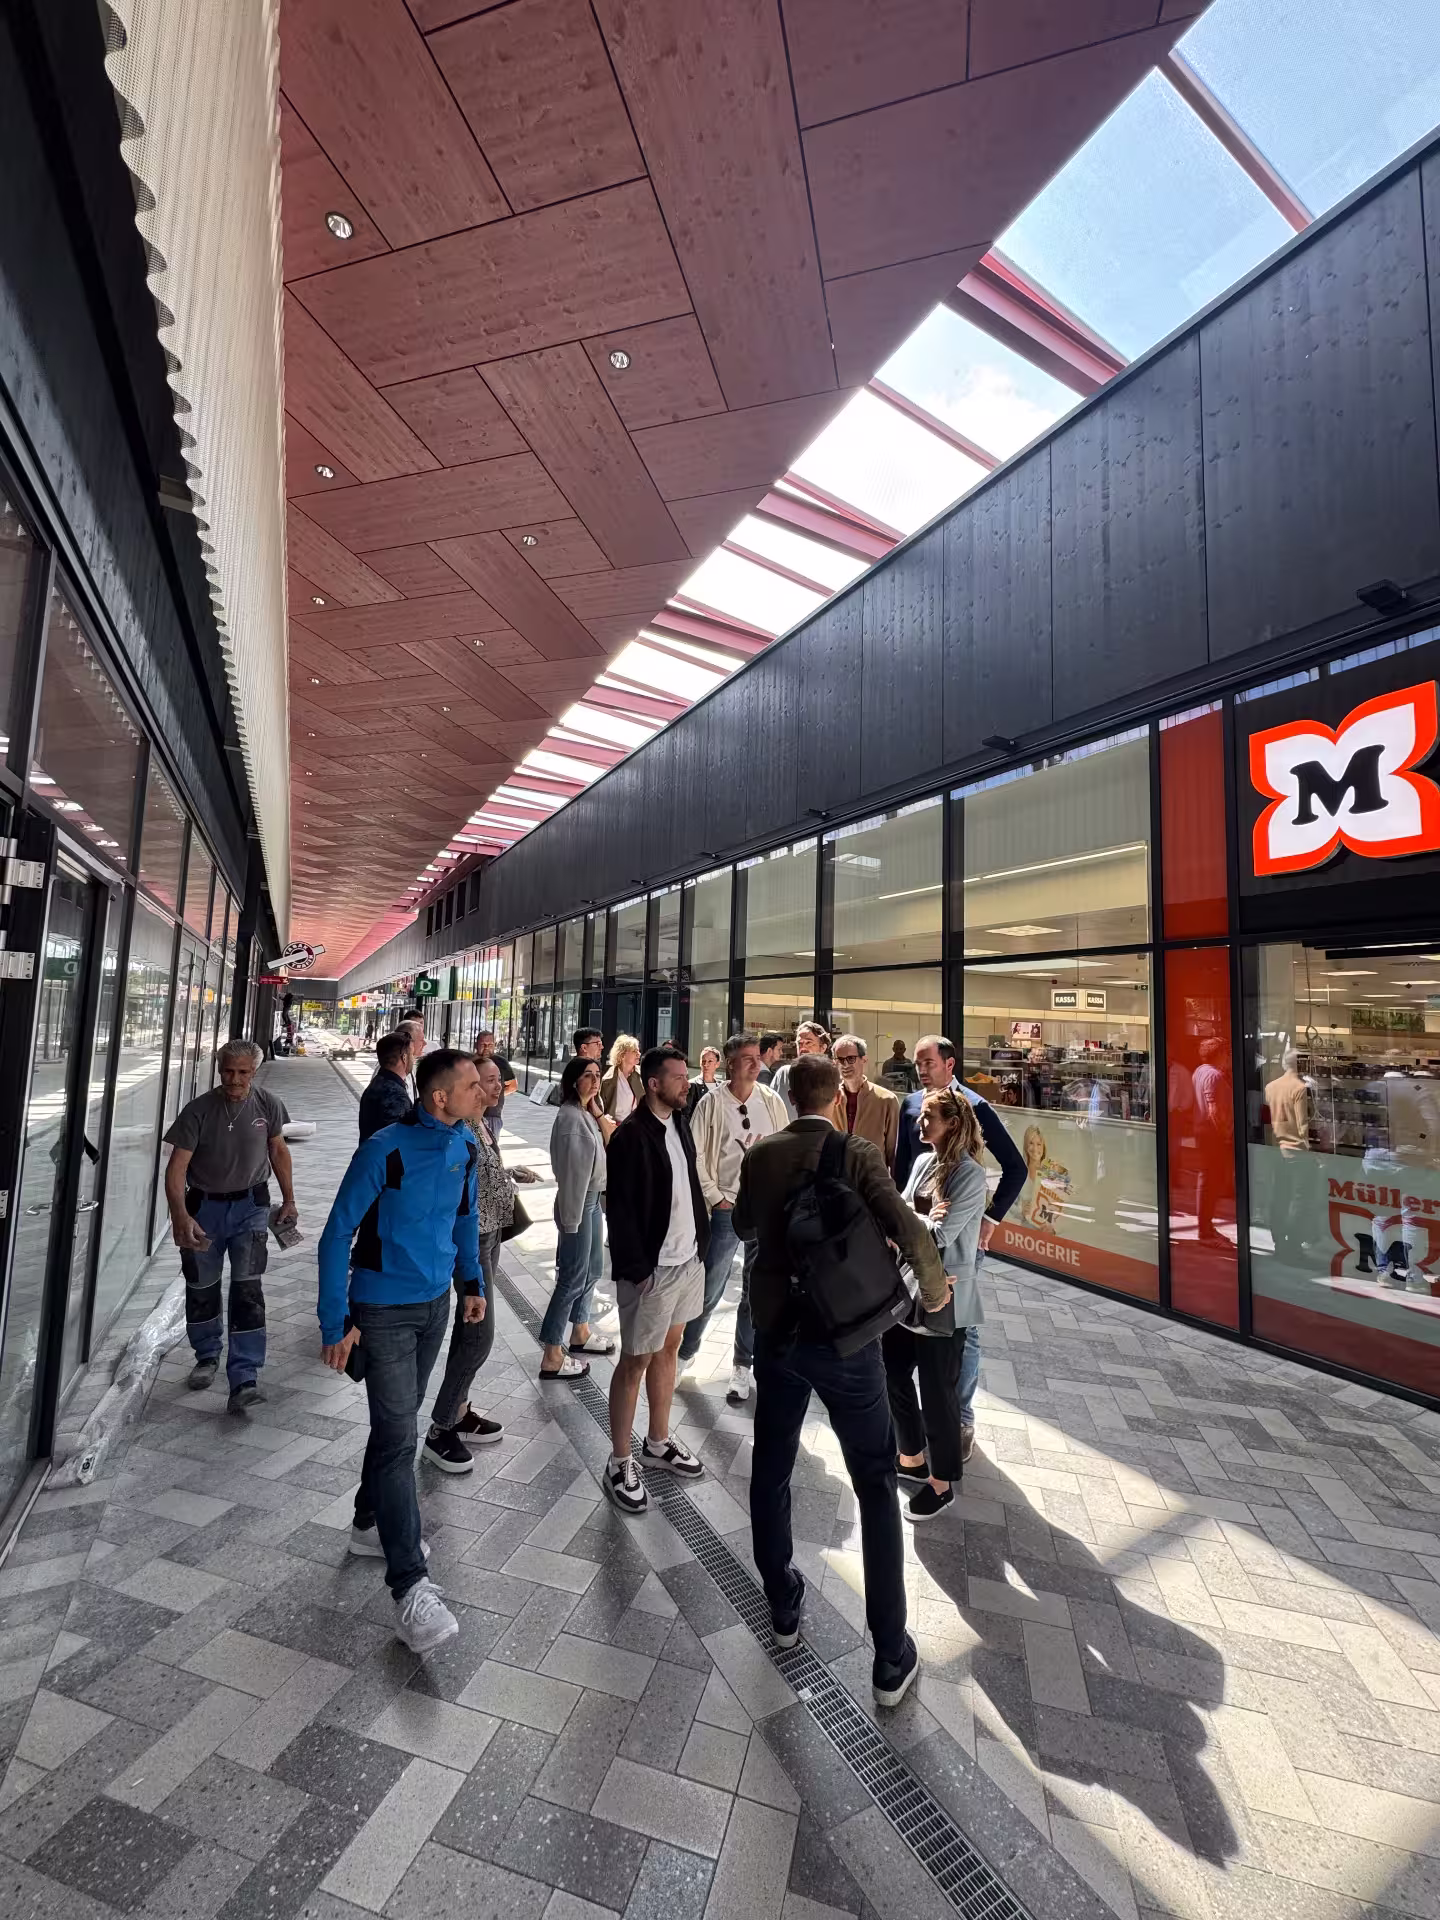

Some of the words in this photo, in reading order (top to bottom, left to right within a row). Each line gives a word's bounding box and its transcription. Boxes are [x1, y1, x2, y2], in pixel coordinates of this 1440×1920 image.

[1289, 744, 1389, 825] M
[419, 980, 432, 991] D
[1328, 1178, 1440, 1214] Müller
[1004, 1229, 1081, 1267] DROGERIE
[1353, 1232, 1413, 1282] M
